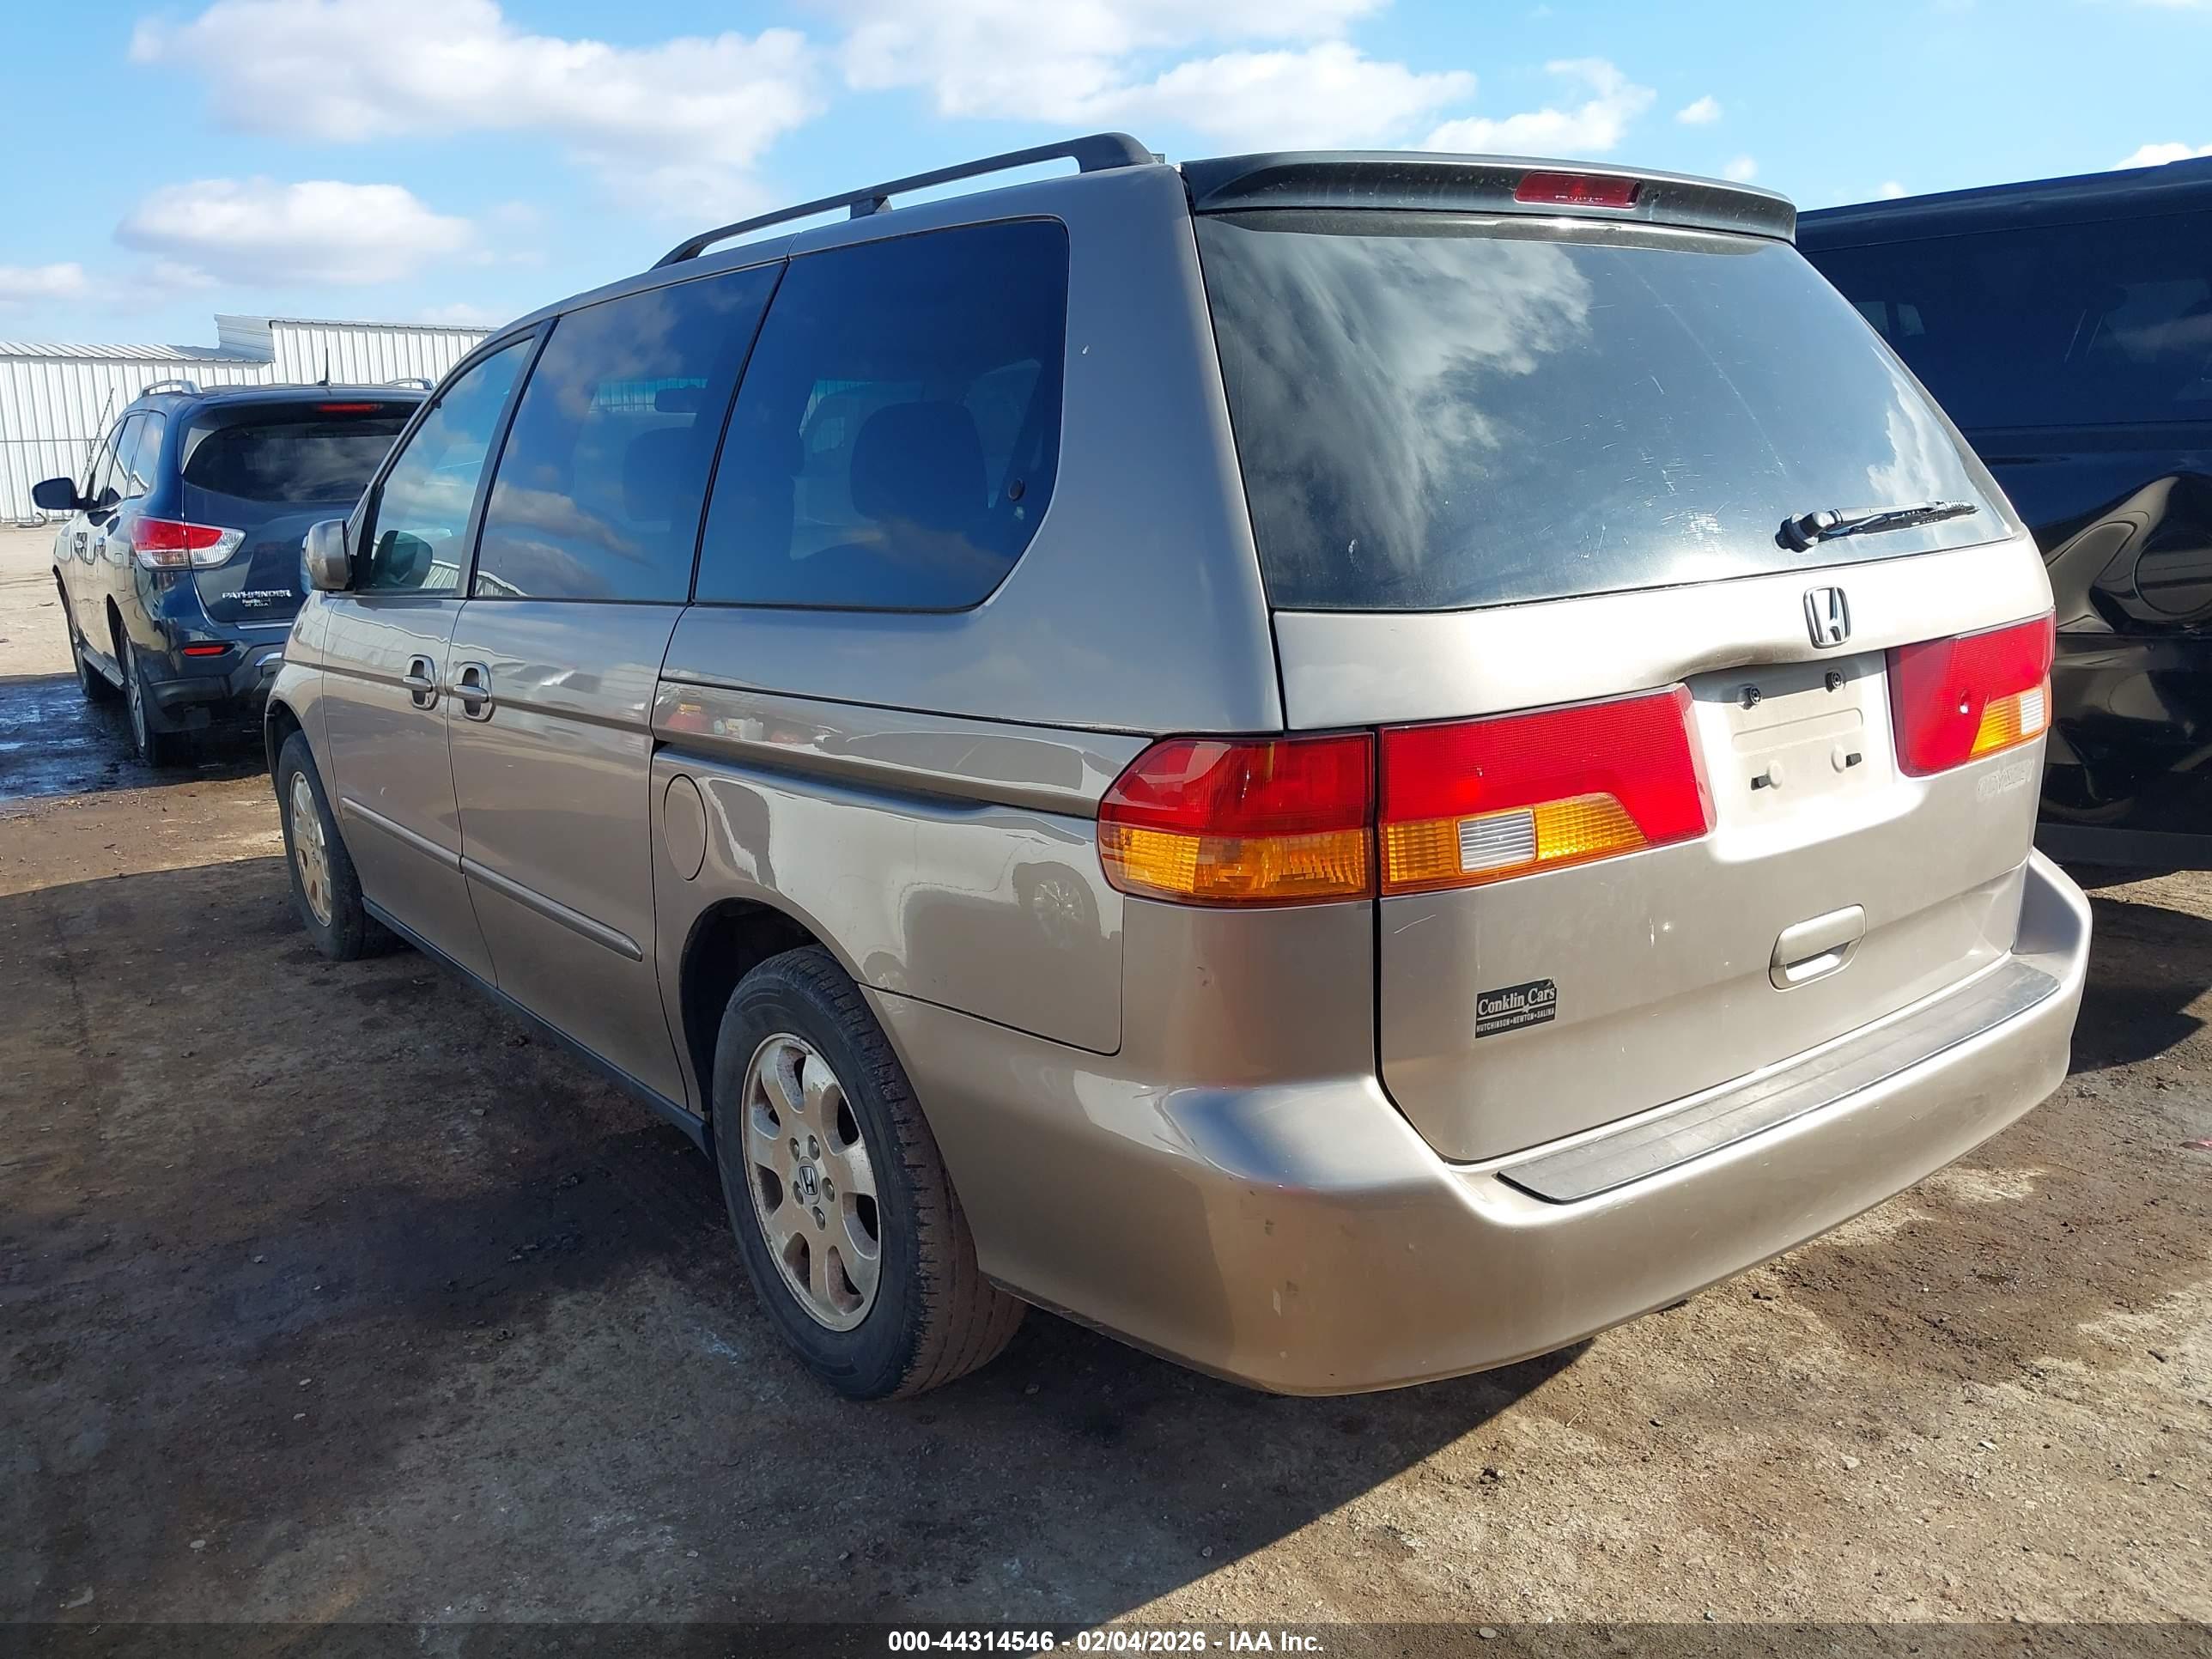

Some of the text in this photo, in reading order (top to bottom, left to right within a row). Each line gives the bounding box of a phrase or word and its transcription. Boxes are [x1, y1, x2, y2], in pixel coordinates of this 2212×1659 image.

[222, 589, 292, 599] PATHFINDER
[1478, 988, 1555, 1016] Conklin Cars
